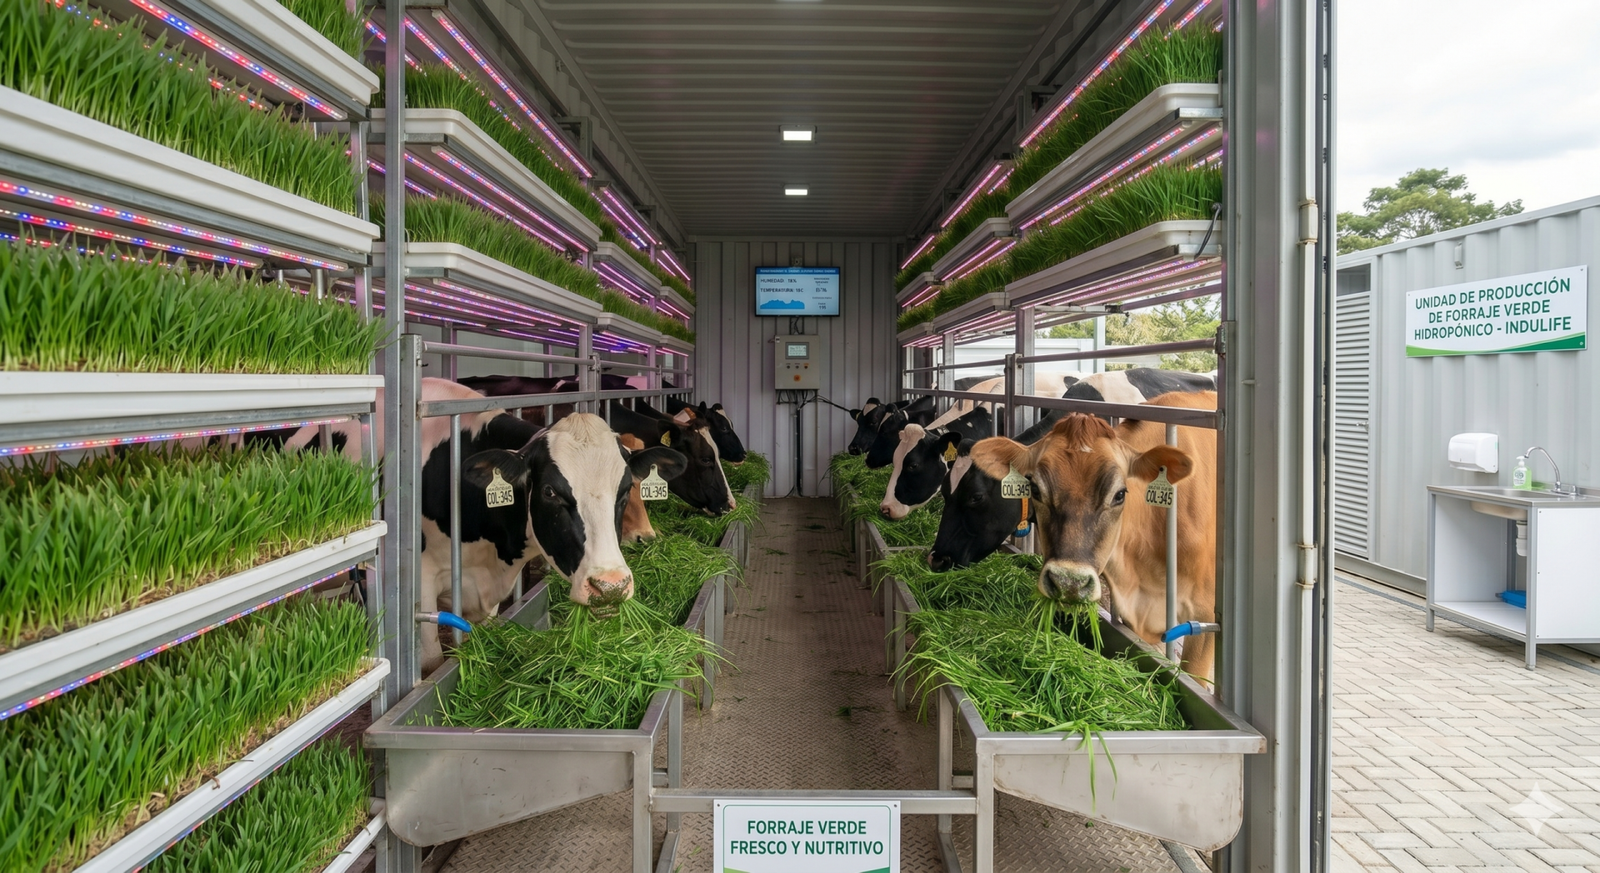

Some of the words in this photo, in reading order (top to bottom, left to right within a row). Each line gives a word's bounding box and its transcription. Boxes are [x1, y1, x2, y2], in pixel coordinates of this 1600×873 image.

[1415, 293, 1457, 310] UNIDAD
[1459, 291, 1475, 304] DE
[1478, 276, 1571, 302] PRODUCCIÓN
[1428, 311, 1443, 324] DE
[1445, 305, 1501, 322] FORRAJE
[1504, 299, 1551, 317] VERDE
[1414, 322, 1493, 340] HIDROPÓNICO
[1505, 316, 1572, 334] INDULIFE
[487, 489, 513, 505] COL-345
[641, 485, 667, 499] COL-345
[1002, 484, 1030, 498] COL-345
[1146, 489, 1173, 506] COL-345
[747, 820, 814, 835] FORRAJE
[818, 820, 867, 835] VERDE
[730, 840, 788, 855] FRESCO
[791, 841, 801, 854] Y
[805, 840, 884, 855] NUTRITIVO
